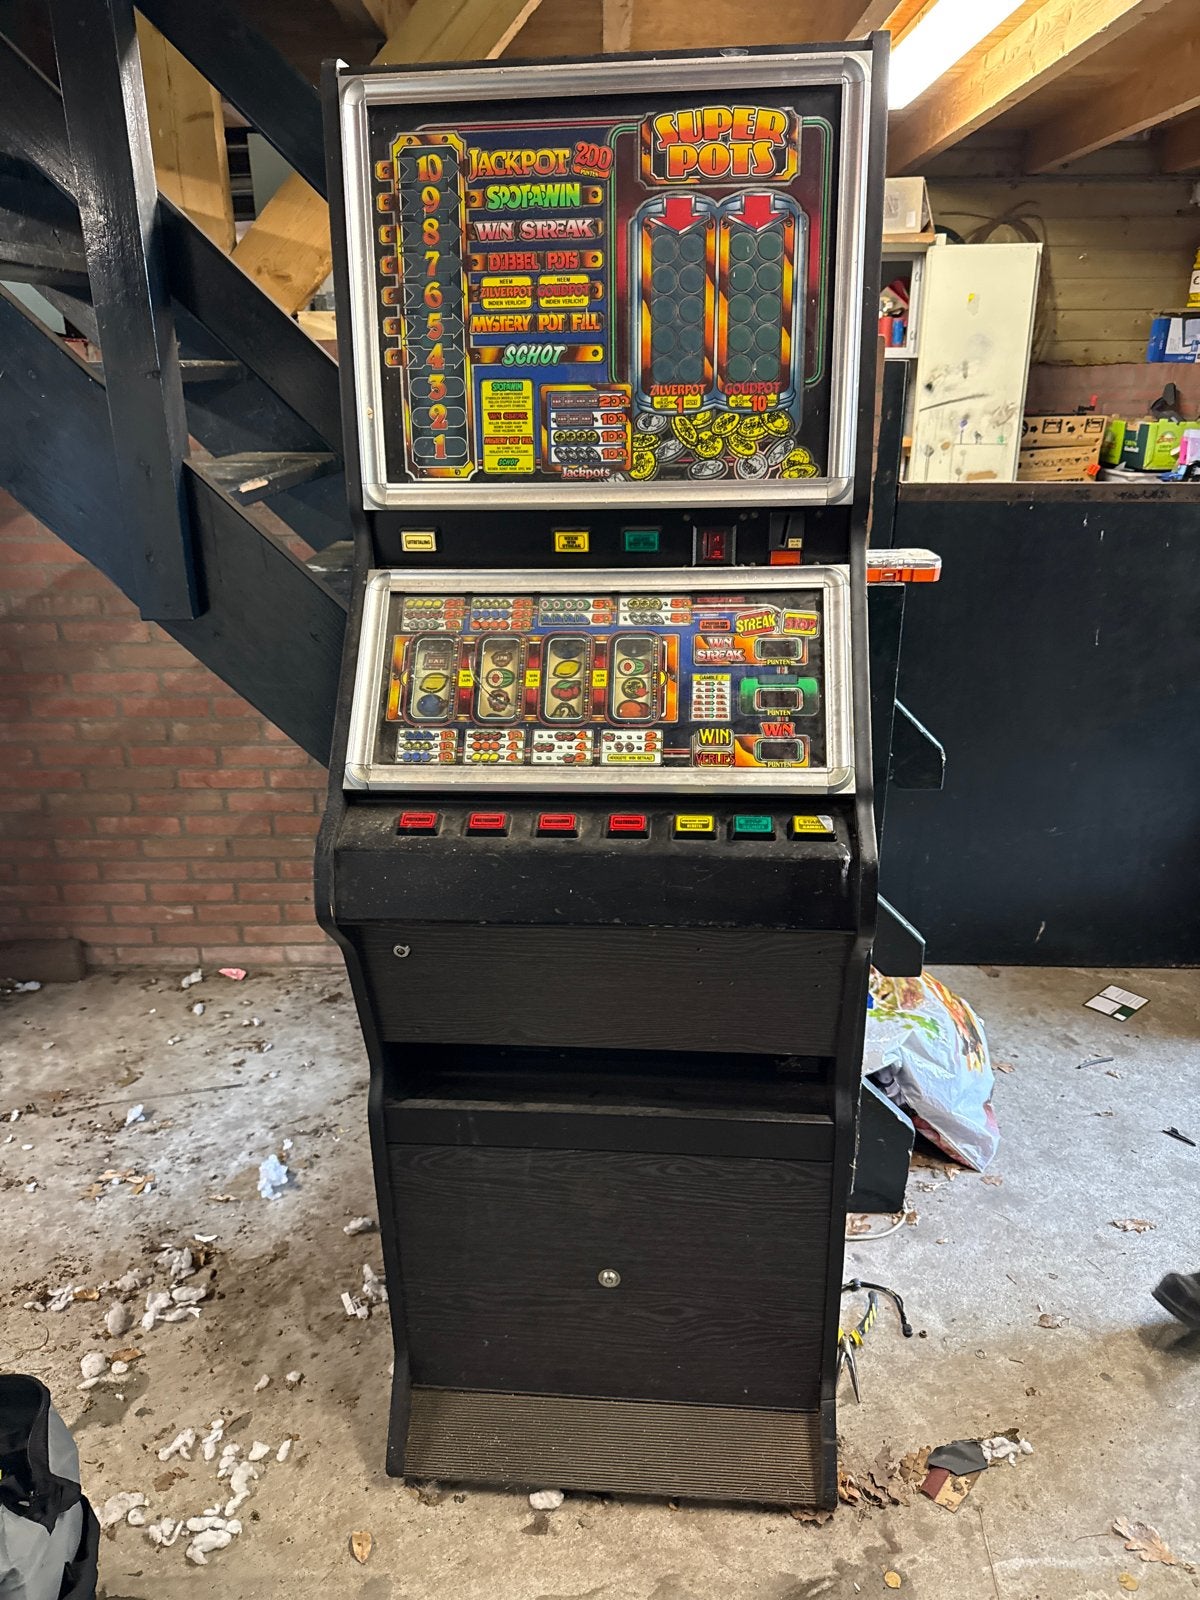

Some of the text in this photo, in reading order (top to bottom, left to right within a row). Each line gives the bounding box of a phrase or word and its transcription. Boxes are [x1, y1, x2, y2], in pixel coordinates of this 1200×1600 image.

[655, 107, 787, 148] SUPER
[574, 142, 612, 169] 200
[667, 140, 774, 177] POTS
[417, 154, 443, 182] 10
[468, 148, 570, 180] JACKPOT
[421, 186, 441, 214] 9
[423, 218, 440, 246] 8
[475, 219, 594, 241] WIN STREAK
[424, 251, 440, 277] 7
[489, 251, 579, 272] DUBBEL POTS
[424, 281, 444, 309] 6
[480, 286, 533, 298] ZILVERPOT
[538, 283, 590, 297] GOUDPOT
[426, 312, 444, 340] 5
[471, 313, 601, 332] MYSTERY POT FILL
[426, 343, 445, 370] 4
[502, 344, 567, 366] SCHOT
[427, 374, 447, 401] 3
[650, 384, 706, 396] ZILVERPOT
[725, 382, 781, 395] GOUDPOT
[598, 395, 631, 408] 200
[674, 396, 684, 414] 1
[751, 395, 767, 411] 10
[429, 404, 448, 430] 2
[601, 413, 627, 425] 100
[601, 431, 628, 443] 100
[433, 434, 447, 460] 1
[602, 448, 628, 460] 100
[561, 465, 611, 479] Jackpots
[592, 598, 613, 609] 50
[670, 598, 692, 608] 50
[591, 613, 612, 623] 50
[670, 613, 692, 623] 50
[736, 613, 776, 633] STREAK
[785, 617, 816, 631] STOP
[708, 637, 732, 648] WIN
[697, 649, 745, 661] STREAK
[766, 658, 791, 666] PUNTEN
[645, 731, 657, 741] 2
[700, 728, 730, 744] WIN
[763, 722, 794, 737] WIN
[645, 742, 657, 752] 2
